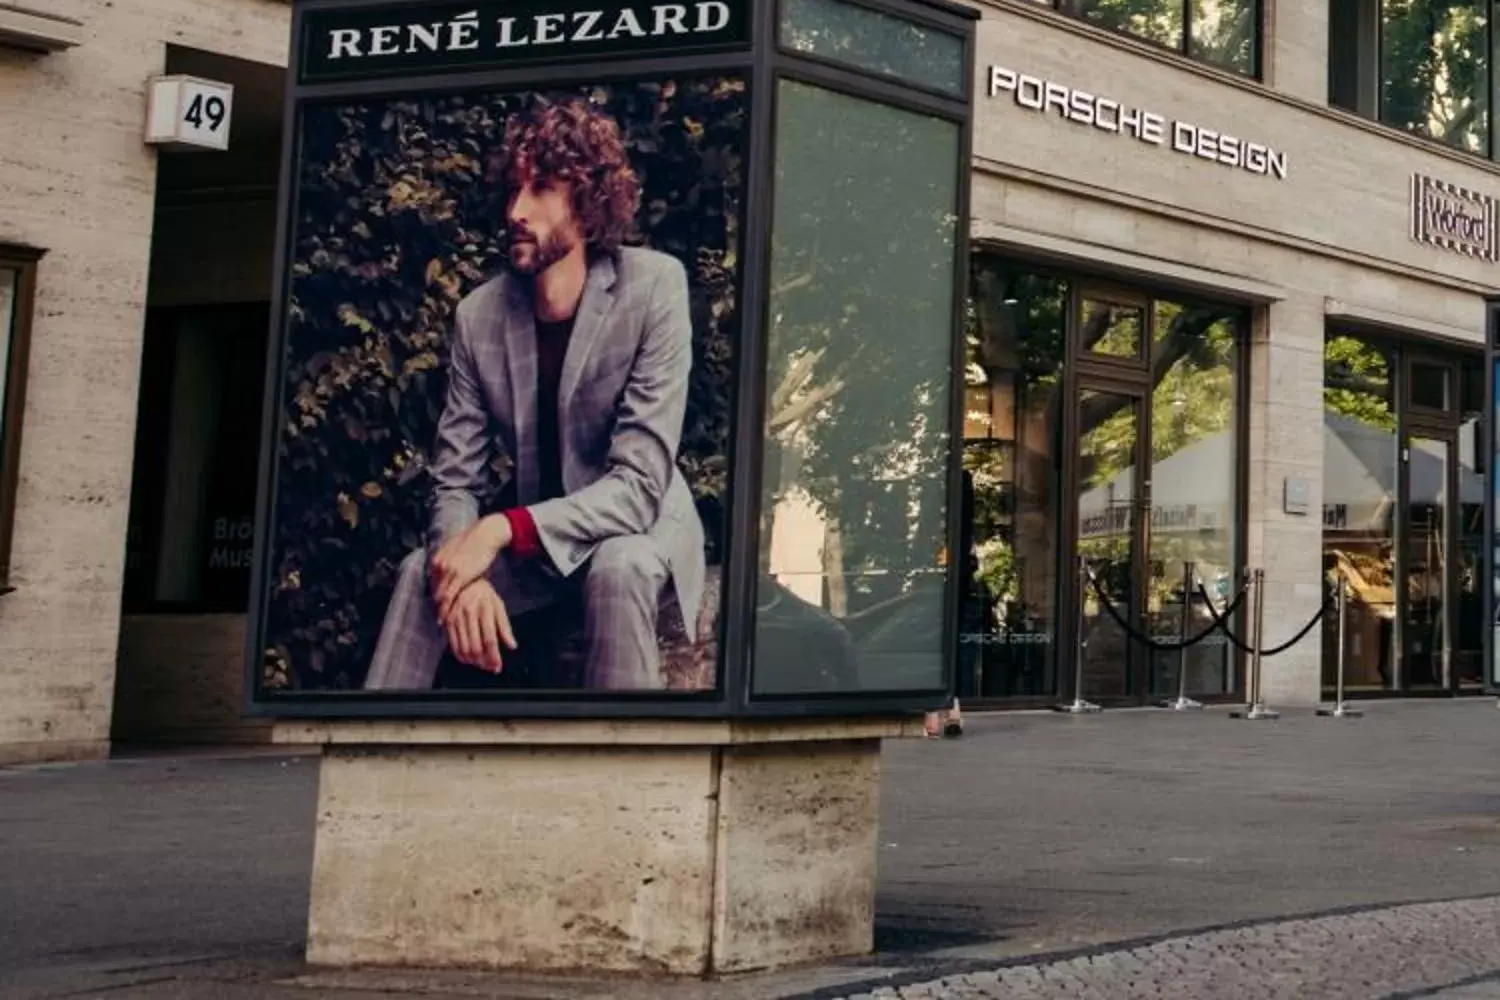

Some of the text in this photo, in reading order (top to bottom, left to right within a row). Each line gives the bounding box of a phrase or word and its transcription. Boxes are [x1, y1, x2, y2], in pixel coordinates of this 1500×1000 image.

[327, 1, 729, 59] RENÉ LEZARD
[184, 93, 225, 131] 49
[988, 65, 1288, 180] PORSCHE DESIGN
[1424, 193, 1485, 241] Wolford
